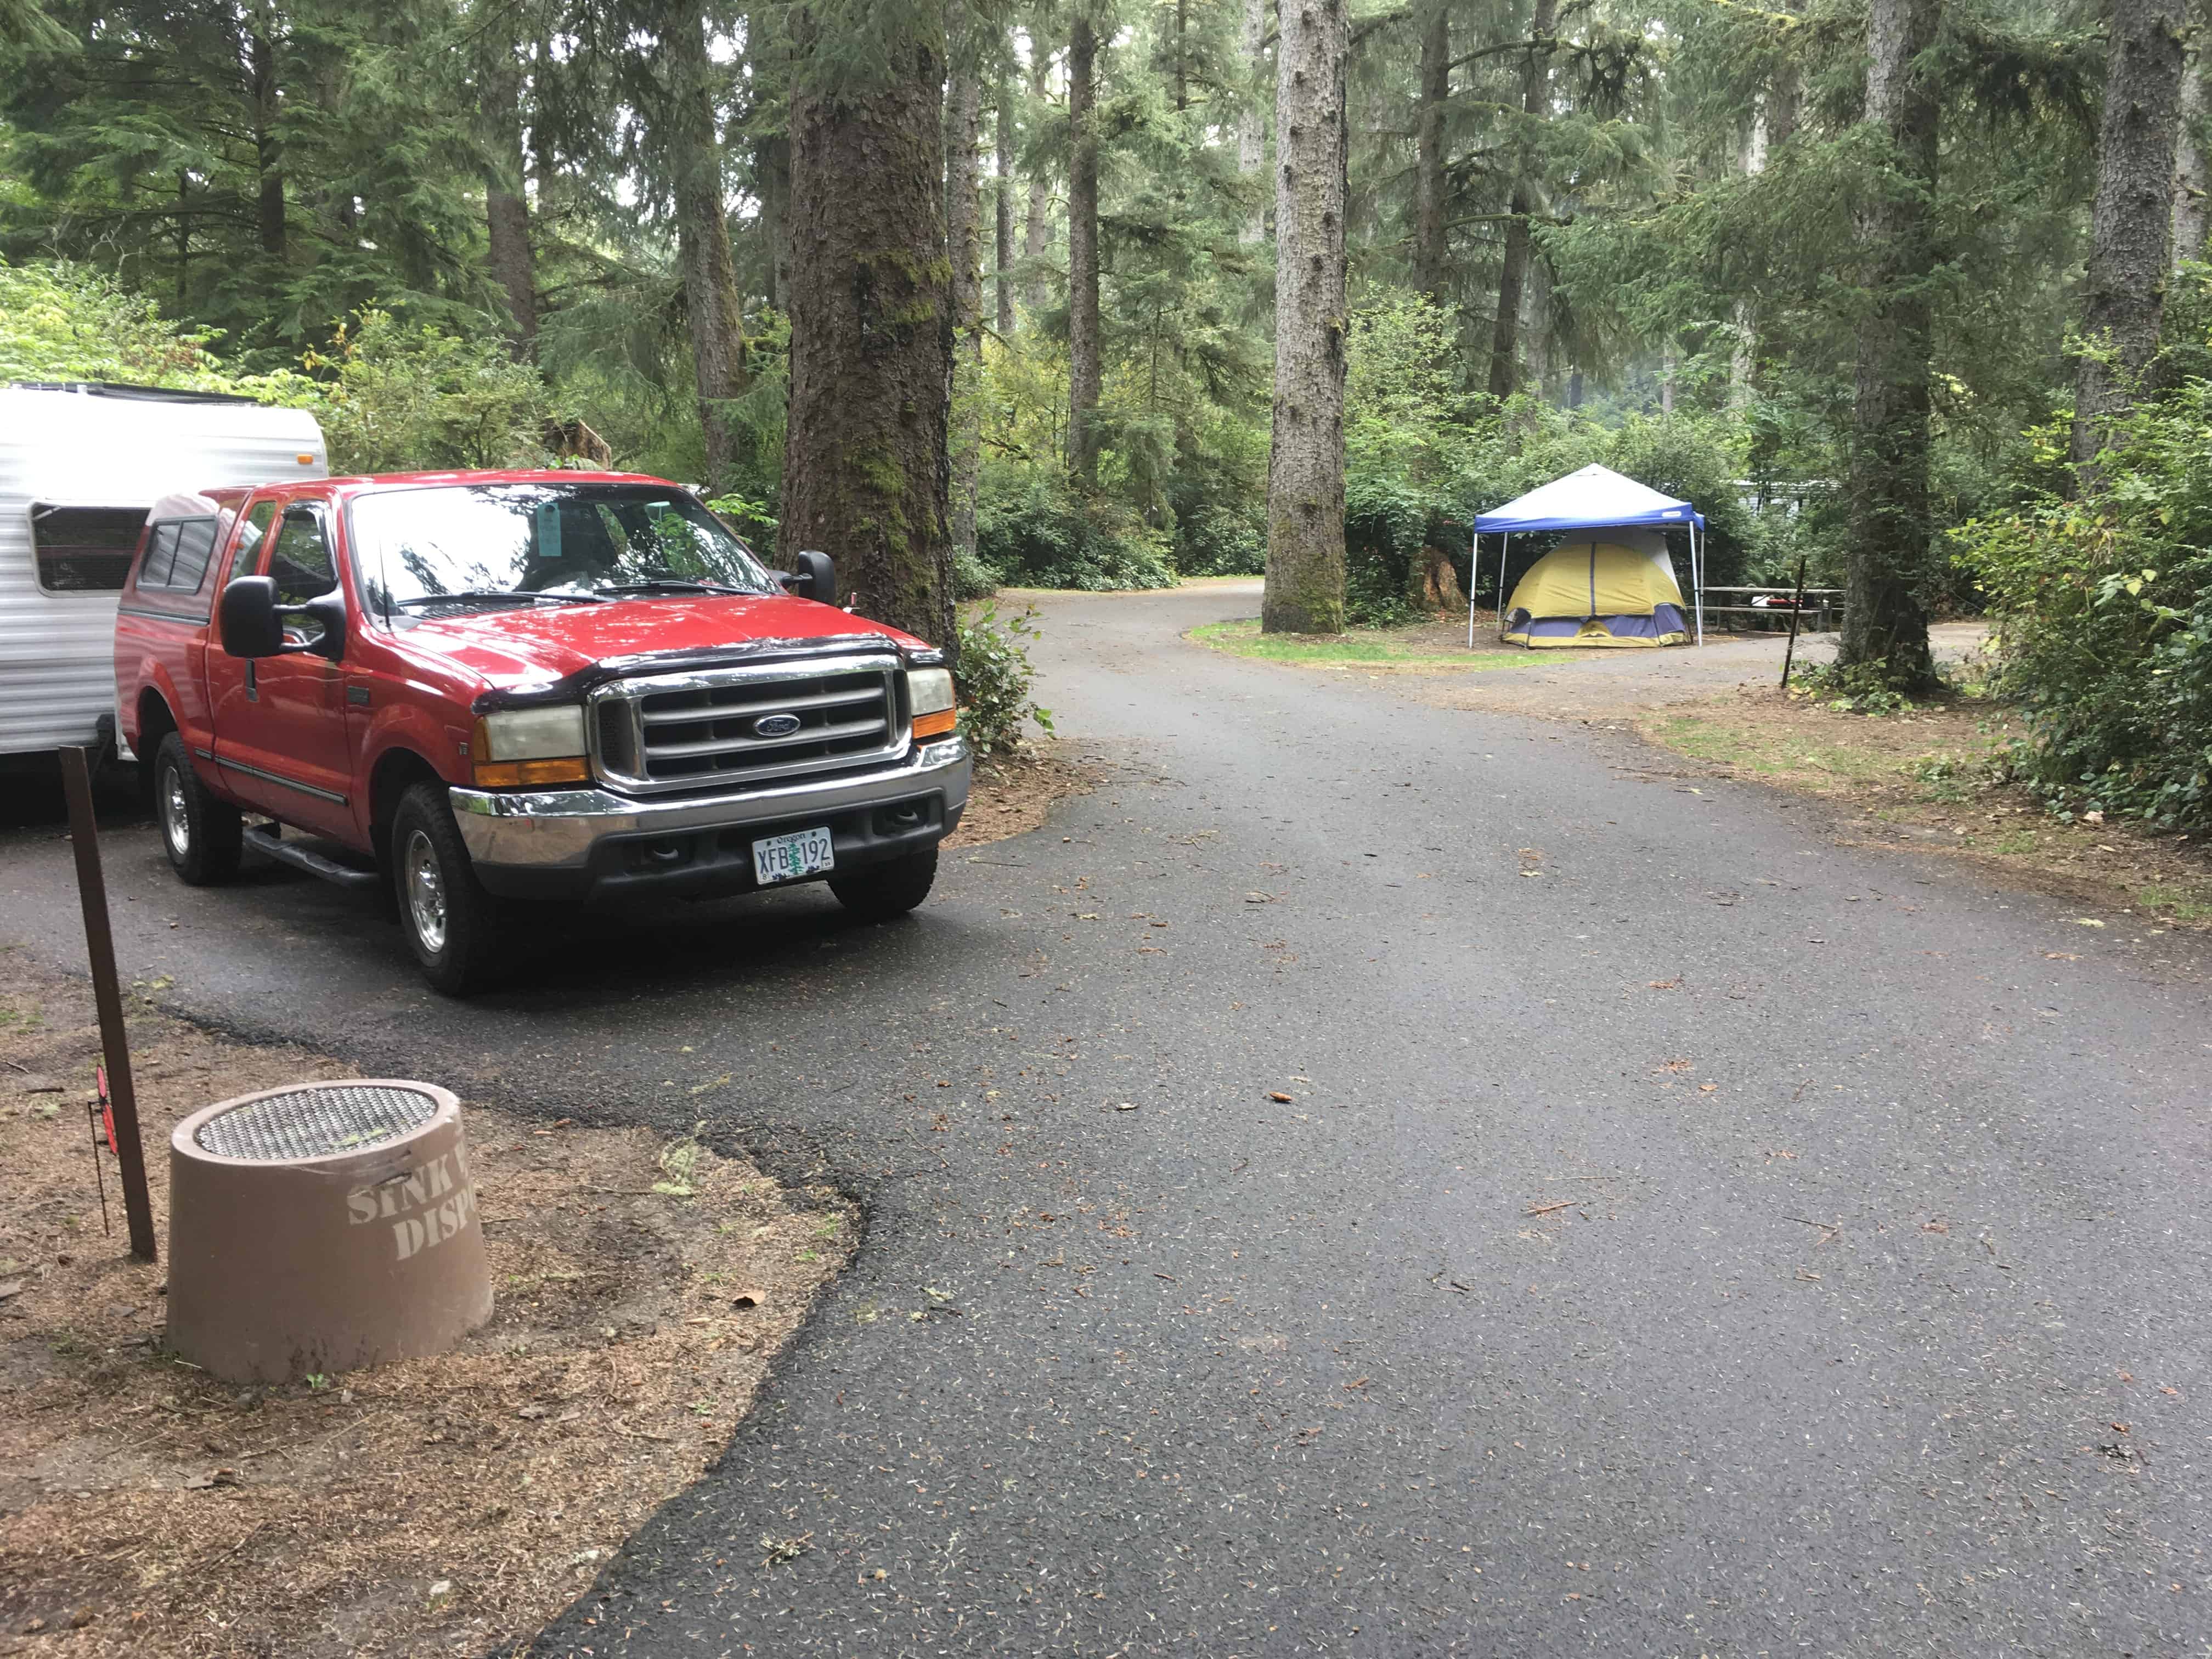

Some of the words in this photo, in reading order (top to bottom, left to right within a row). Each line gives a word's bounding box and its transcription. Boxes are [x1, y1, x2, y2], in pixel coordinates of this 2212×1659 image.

[757, 846, 789, 874] XFB
[800, 838, 830, 865] 192
[777, 832, 806, 844] Oregon
[346, 1153, 453, 1225] SINK
